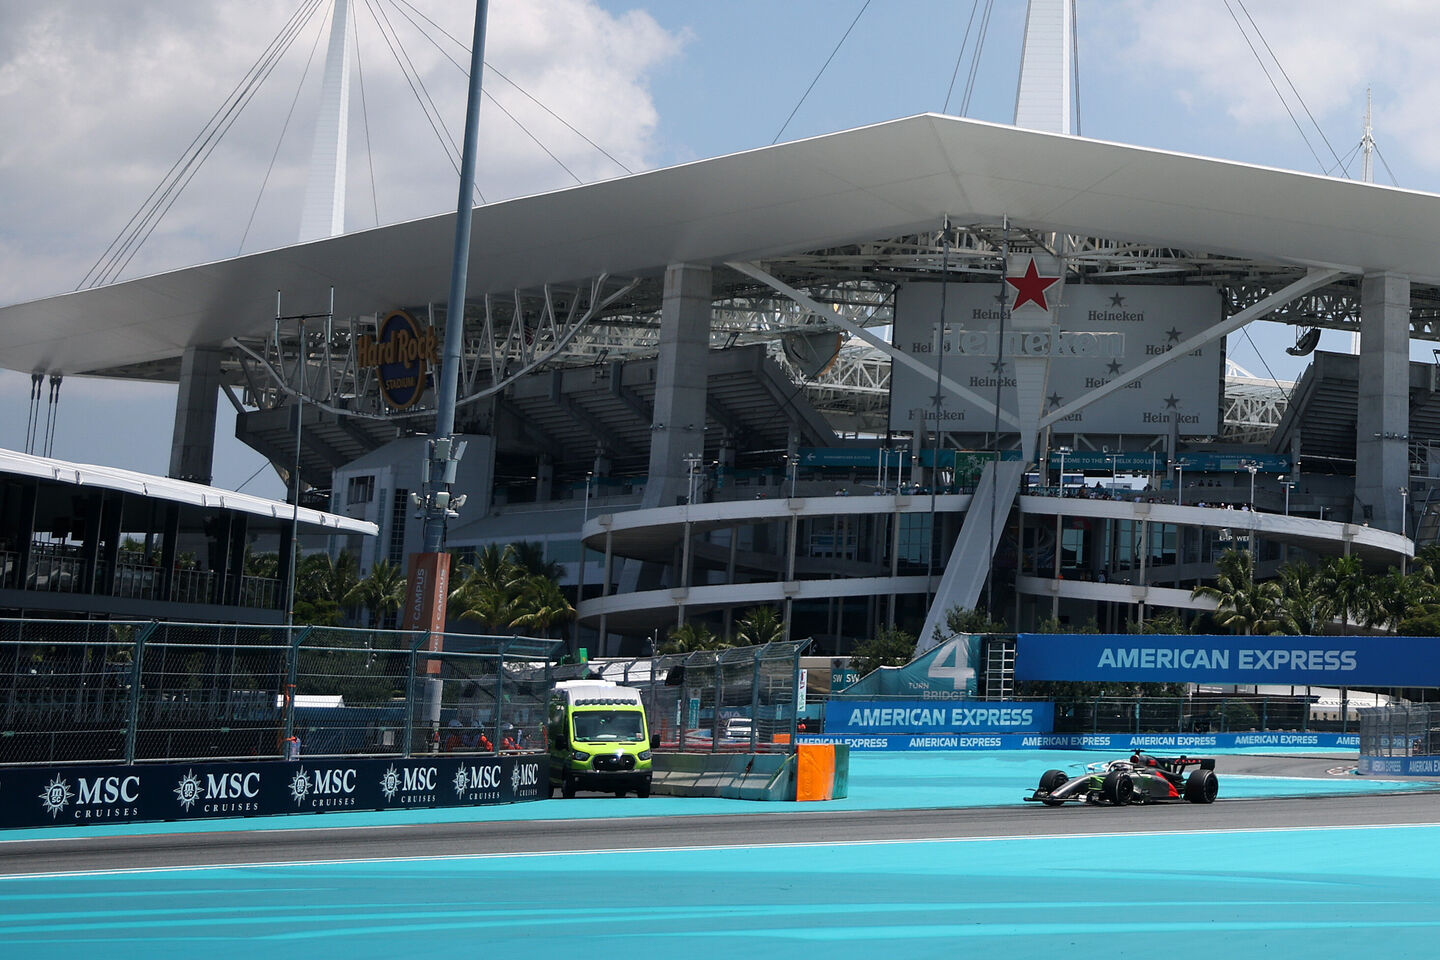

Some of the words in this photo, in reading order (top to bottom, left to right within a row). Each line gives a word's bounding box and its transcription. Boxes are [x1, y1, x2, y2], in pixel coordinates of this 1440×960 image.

[973, 309, 1011, 320] Heine
[1088, 311, 1144, 322] Heineken
[357, 330, 395, 369] Hard
[397, 325, 440, 369] Rock
[969, 376, 1017, 388] Heineke
[908, 409, 965, 421] Hineken
[1143, 412, 1199, 424] Heinken
[412, 568, 425, 621] CAMPUS
[928, 637, 975, 690] 4
[1097, 648, 1230, 669] AMERICAN
[1238, 650, 1357, 671] EXPRESS
[832, 674, 843, 683] SW
[846, 673, 861, 683] SW
[908, 681, 929, 690] TURN
[848, 709, 946, 726] AMERICAN
[951, 709, 1033, 726] EXPRESS
[844, 738, 888, 748] EXPRESS
[909, 737, 958, 747] AMERICAN
[960, 737, 1001, 747] EXPRESS
[1021, 737, 1069, 746] AMERICAN
[1071, 736, 1111, 746] EXPRESS
[1130, 736, 1175, 746] AMERICAN
[1177, 736, 1217, 745] EXPRESS
[1235, 735, 1278, 744] AMERICAN
[1280, 735, 1318, 744] EXPRESS
[1409, 760, 1433, 772] AMERICAN
[402, 767, 438, 791] MSC
[470, 765, 501, 788] MSC
[520, 763, 538, 785] MSC
[205, 772, 260, 799] MSC
[313, 769, 357, 794] MSC
[76, 776, 140, 805] MSC
[469, 791, 500, 800] CRUISES
[312, 797, 355, 807] CRUISES
[401, 794, 436, 803] CRUISES
[75, 807, 138, 819] CRUISES
[204, 802, 259, 813] CRUISES
